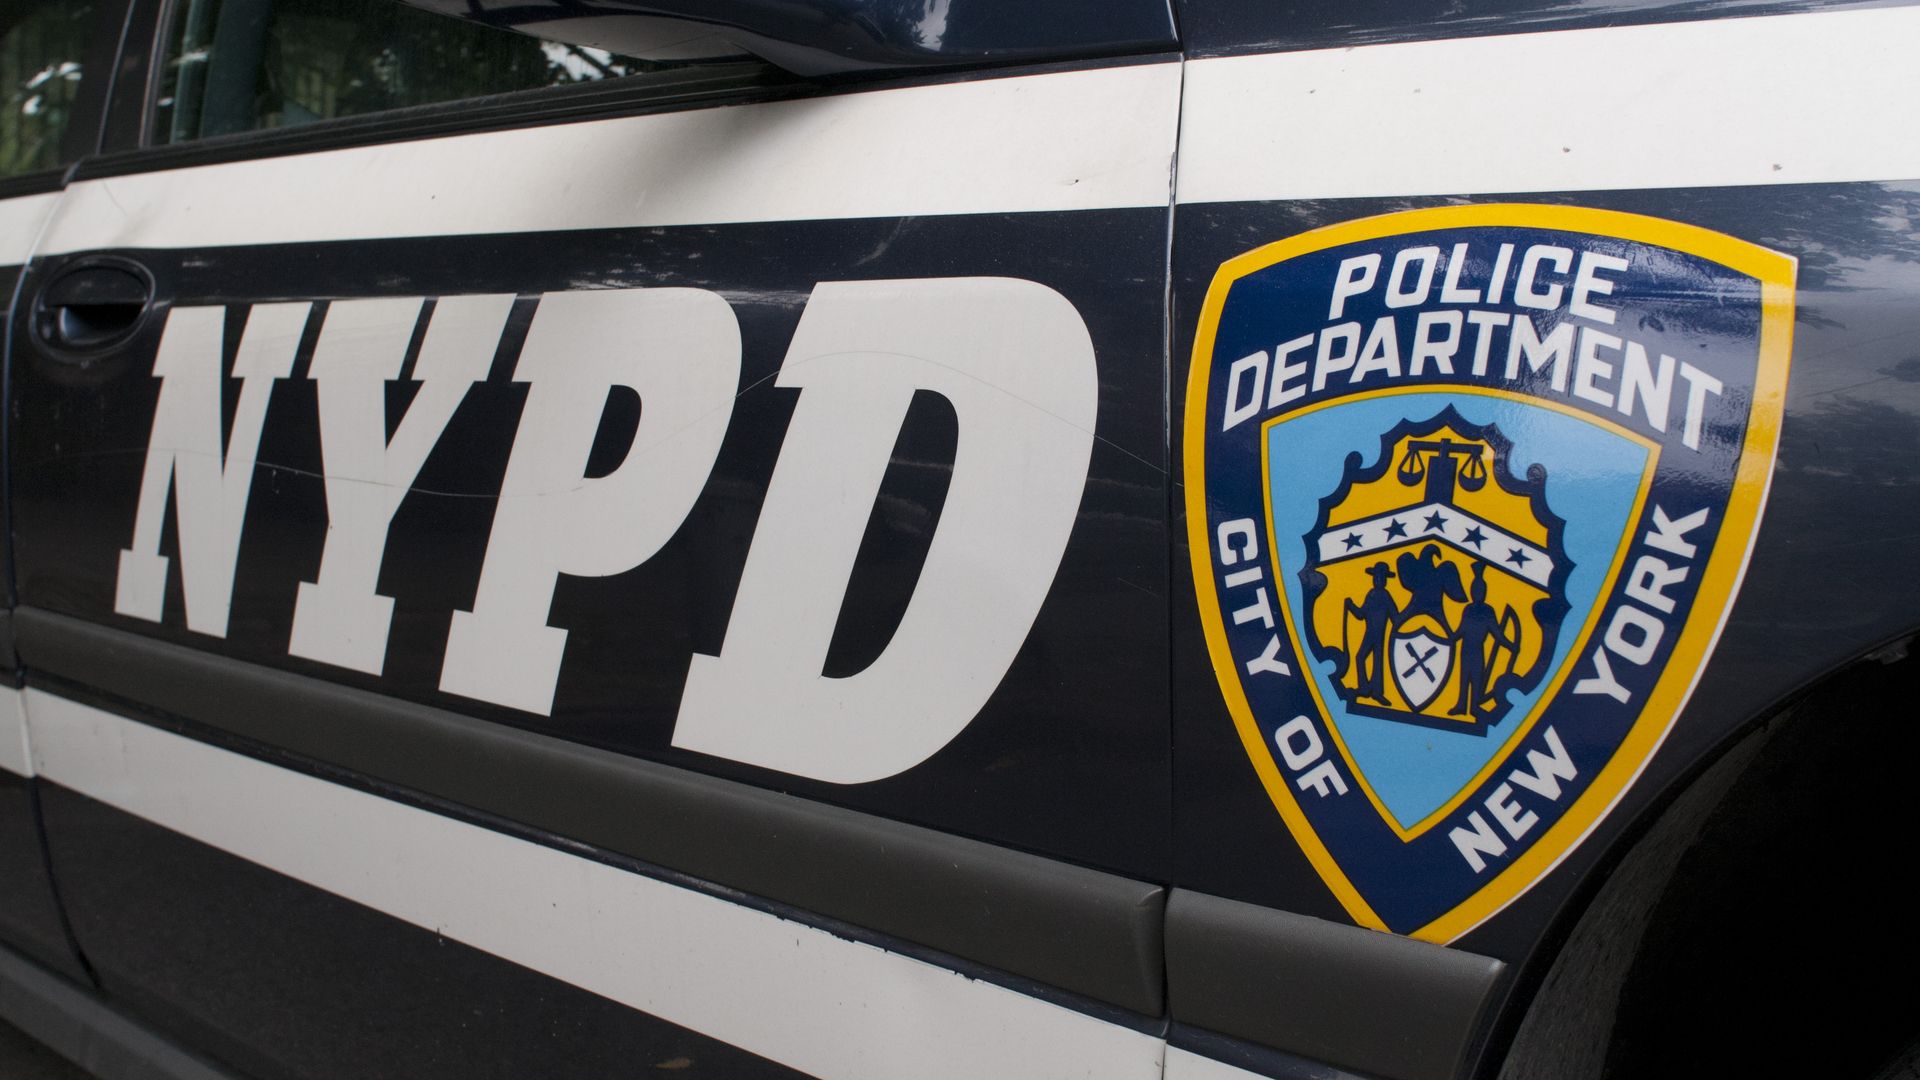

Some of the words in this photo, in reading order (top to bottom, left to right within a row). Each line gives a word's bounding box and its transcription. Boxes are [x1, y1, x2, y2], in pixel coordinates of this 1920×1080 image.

[1222, 309, 1723, 451] DEPARTMENT
[1328, 242, 1629, 325] POLICE
[114, 276, 1098, 784] NYPD
[1217, 517, 1291, 680] CITY
[1274, 714, 1348, 799] OF
[1448, 725, 1578, 874] NEW
[1573, 503, 1710, 704] YORK
